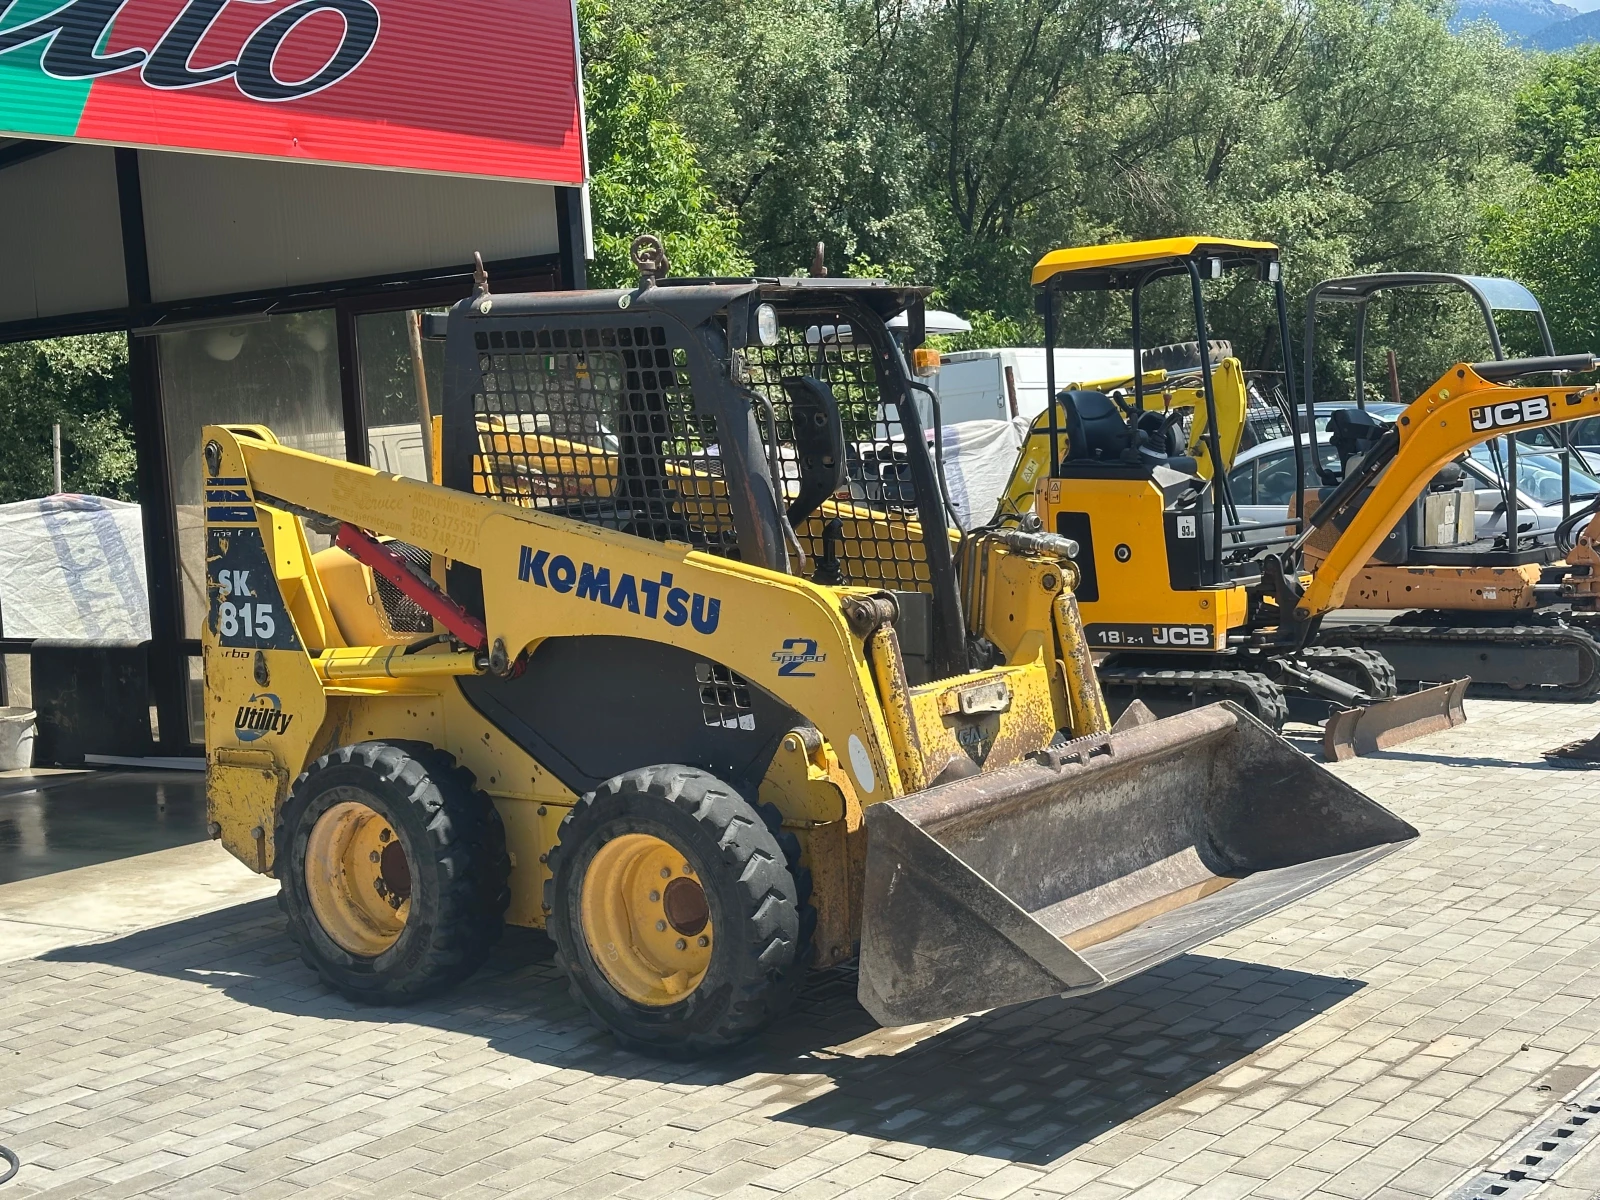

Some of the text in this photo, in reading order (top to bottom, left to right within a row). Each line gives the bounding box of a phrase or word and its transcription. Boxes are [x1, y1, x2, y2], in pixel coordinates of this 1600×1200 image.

[1472, 398, 1549, 430] JCB
[218, 569, 250, 597] SK
[518, 544, 721, 635] KOMATSU
[219, 602, 275, 639] 815
[1098, 631, 1120, 644] 18
[1152, 627, 1209, 645] JCB
[771, 653, 826, 664] Speed
[235, 706, 293, 735] Utility
